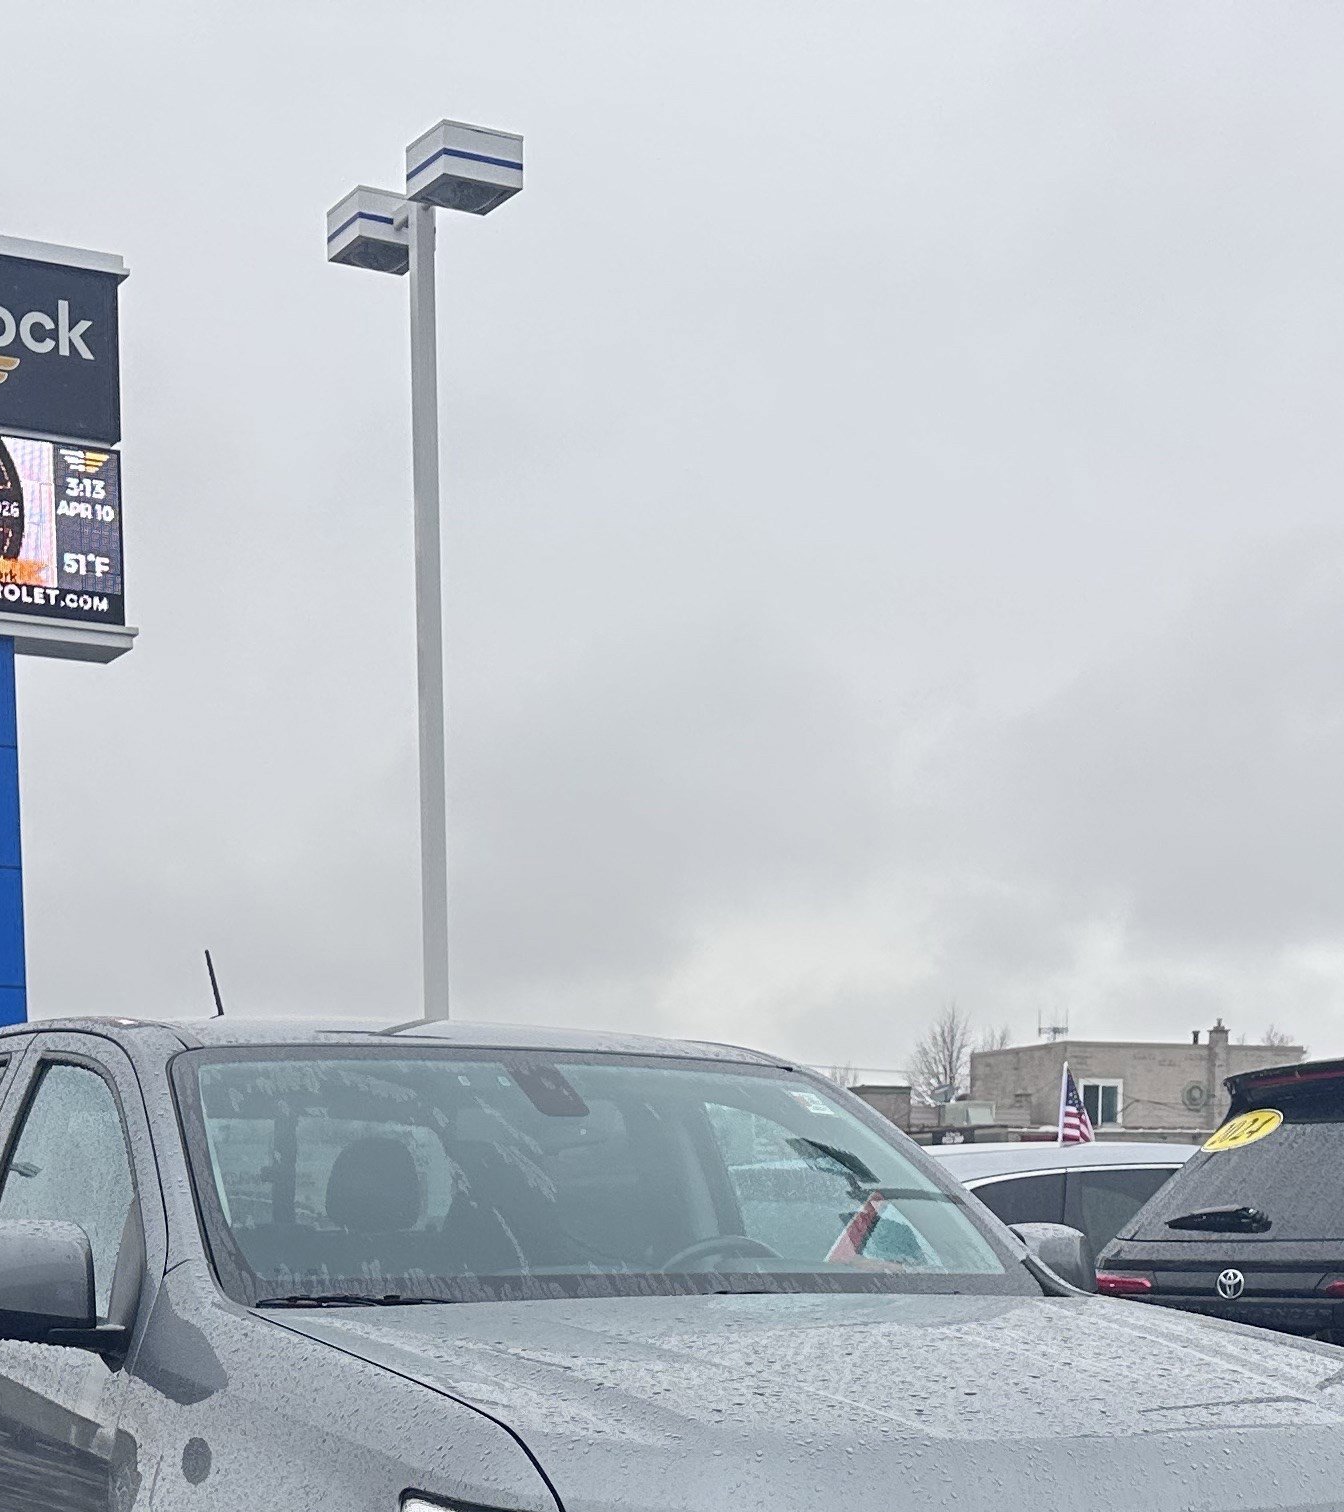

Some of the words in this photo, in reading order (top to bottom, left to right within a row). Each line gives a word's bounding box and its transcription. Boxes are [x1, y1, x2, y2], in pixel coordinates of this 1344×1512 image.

[66, 477, 106, 499] 3:13
[56, 500, 93, 519] APR
[95, 504, 115, 522] 10
